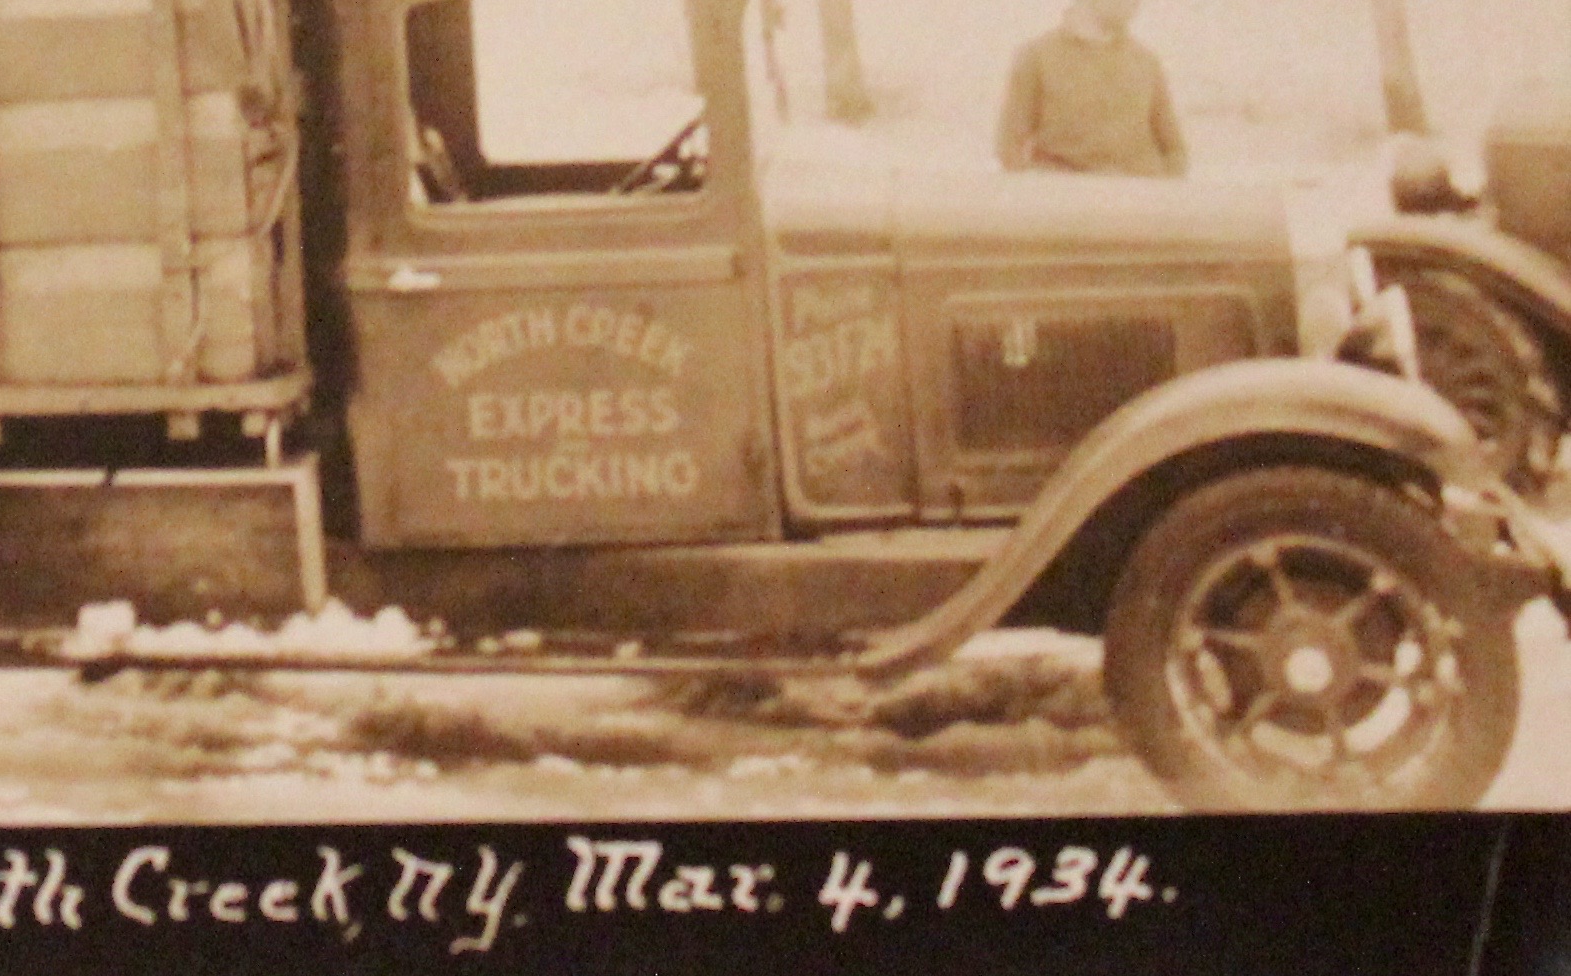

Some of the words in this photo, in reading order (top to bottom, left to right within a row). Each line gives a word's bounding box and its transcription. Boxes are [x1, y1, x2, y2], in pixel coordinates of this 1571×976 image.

[431, 307, 556, 388] NORTH
[565, 303, 694, 376] CREEK
[467, 388, 681, 439] EXPRESS
[445, 450, 700, 501] TRUCKING
